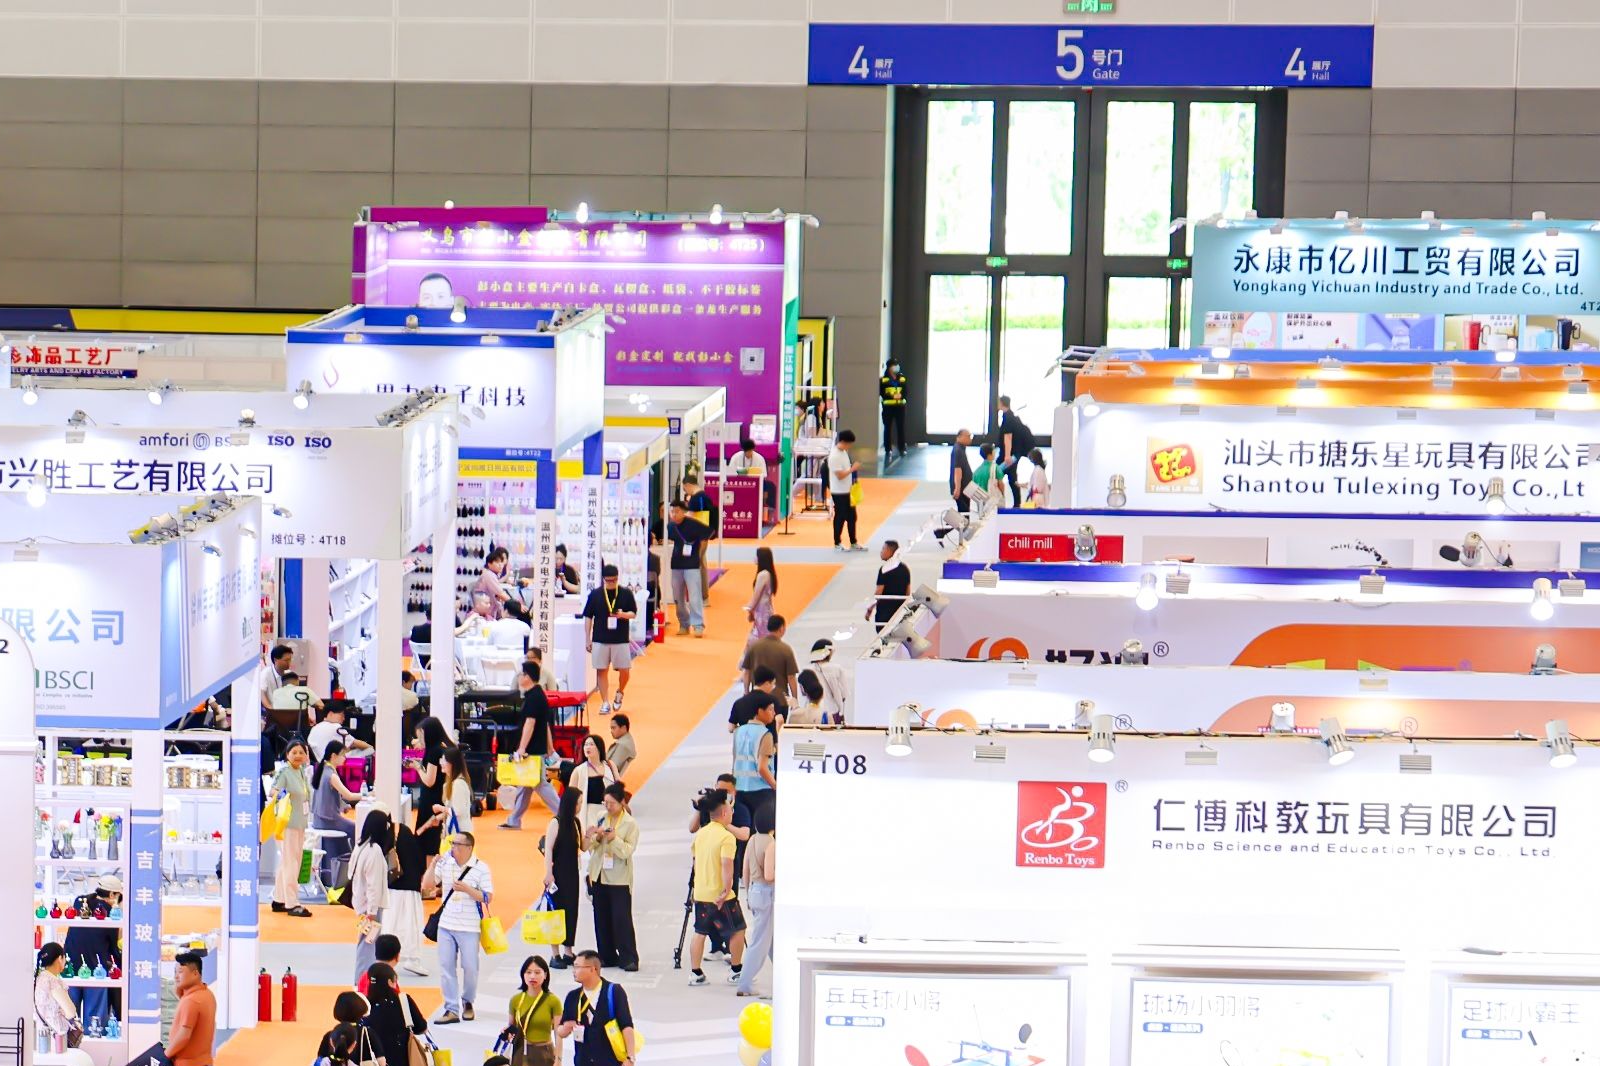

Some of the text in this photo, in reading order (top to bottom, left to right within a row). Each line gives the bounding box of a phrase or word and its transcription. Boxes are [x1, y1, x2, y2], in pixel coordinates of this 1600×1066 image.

[848, 46, 869, 78] 4
[1056, 30, 1123, 80] 5 号门
[1284, 48, 1306, 81] 4
[874, 70, 893, 79] Hall
[1092, 68, 1120, 80] Gate
[1312, 71, 1330, 81] Hall
[1233, 242, 1582, 278] 永康市亿川工贸有限公司
[1233, 279, 1584, 298] Yongkang Yichuan Industry and Trade Co., Ltd.
[138, 433, 190, 448] amfori
[267, 434, 332, 448] ISO ISO
[1222, 475, 1440, 500] Shantou Tulexing
[1007, 536, 1053, 550] chili mill
[44, 669, 95, 692] BSCI
[798, 753, 867, 775] 4T08
[1152, 798, 1558, 841] 仁博科教玩具有限公司
[236, 777, 251, 897] 吉丰玻璃
[1152, 839, 1205, 852] Renbo
[1212, 841, 1283, 853] Science
[1290, 842, 1321, 854] and
[1327, 842, 1417, 856] Education
[1425, 844, 1469, 858] Toys
[1024, 852, 1096, 868] Renbo Toys
[134, 850, 154, 979] 吉丰玻璃
[825, 988, 942, 1012] 乒乓球小将
[1463, 1000, 1581, 1024] 足球小霸王
